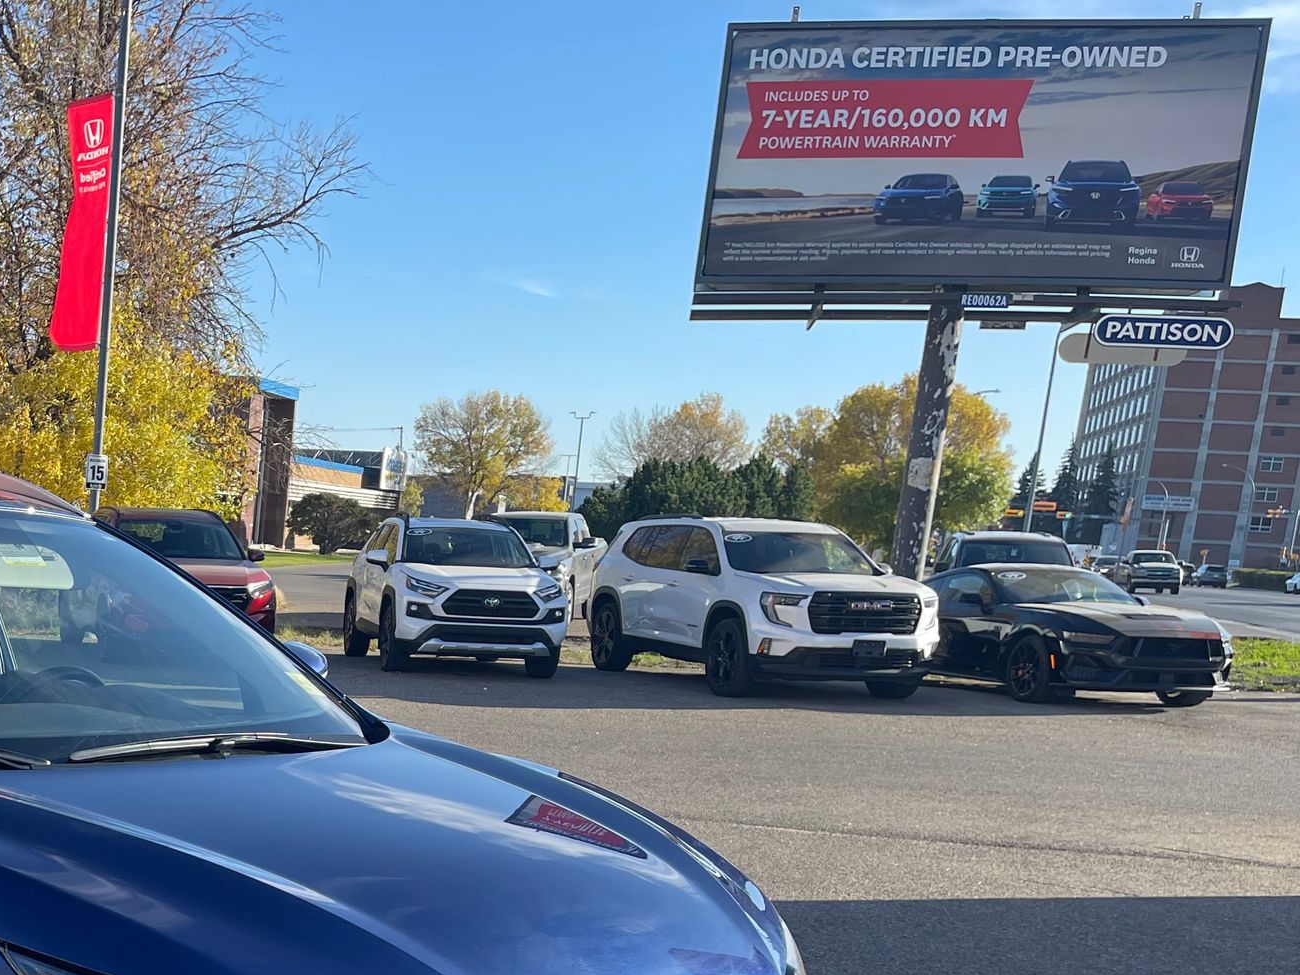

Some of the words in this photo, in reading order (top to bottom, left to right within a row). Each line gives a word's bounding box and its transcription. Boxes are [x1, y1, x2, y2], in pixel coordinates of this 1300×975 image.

[749, 48, 845, 70] HONDA
[852, 46, 992, 68] CERTIFIED
[998, 46, 1168, 68] PRE-OWNED
[764, 90, 828, 102] INCLUDES
[831, 90, 850, 101] UP
[852, 89, 869, 101] TO
[761, 106, 961, 130] 7-YEAR/160,000
[968, 108, 1008, 128] KM
[758, 136, 860, 149] POWERTRAIN
[1128, 246, 1158, 256] Regina
[1127, 256, 1156, 265] Honda
[961, 294, 1007, 306] RE00062A
[1105, 321, 1223, 343] PATTISON
[90, 465, 104, 481] 15
[847, 600, 892, 611] GMC
